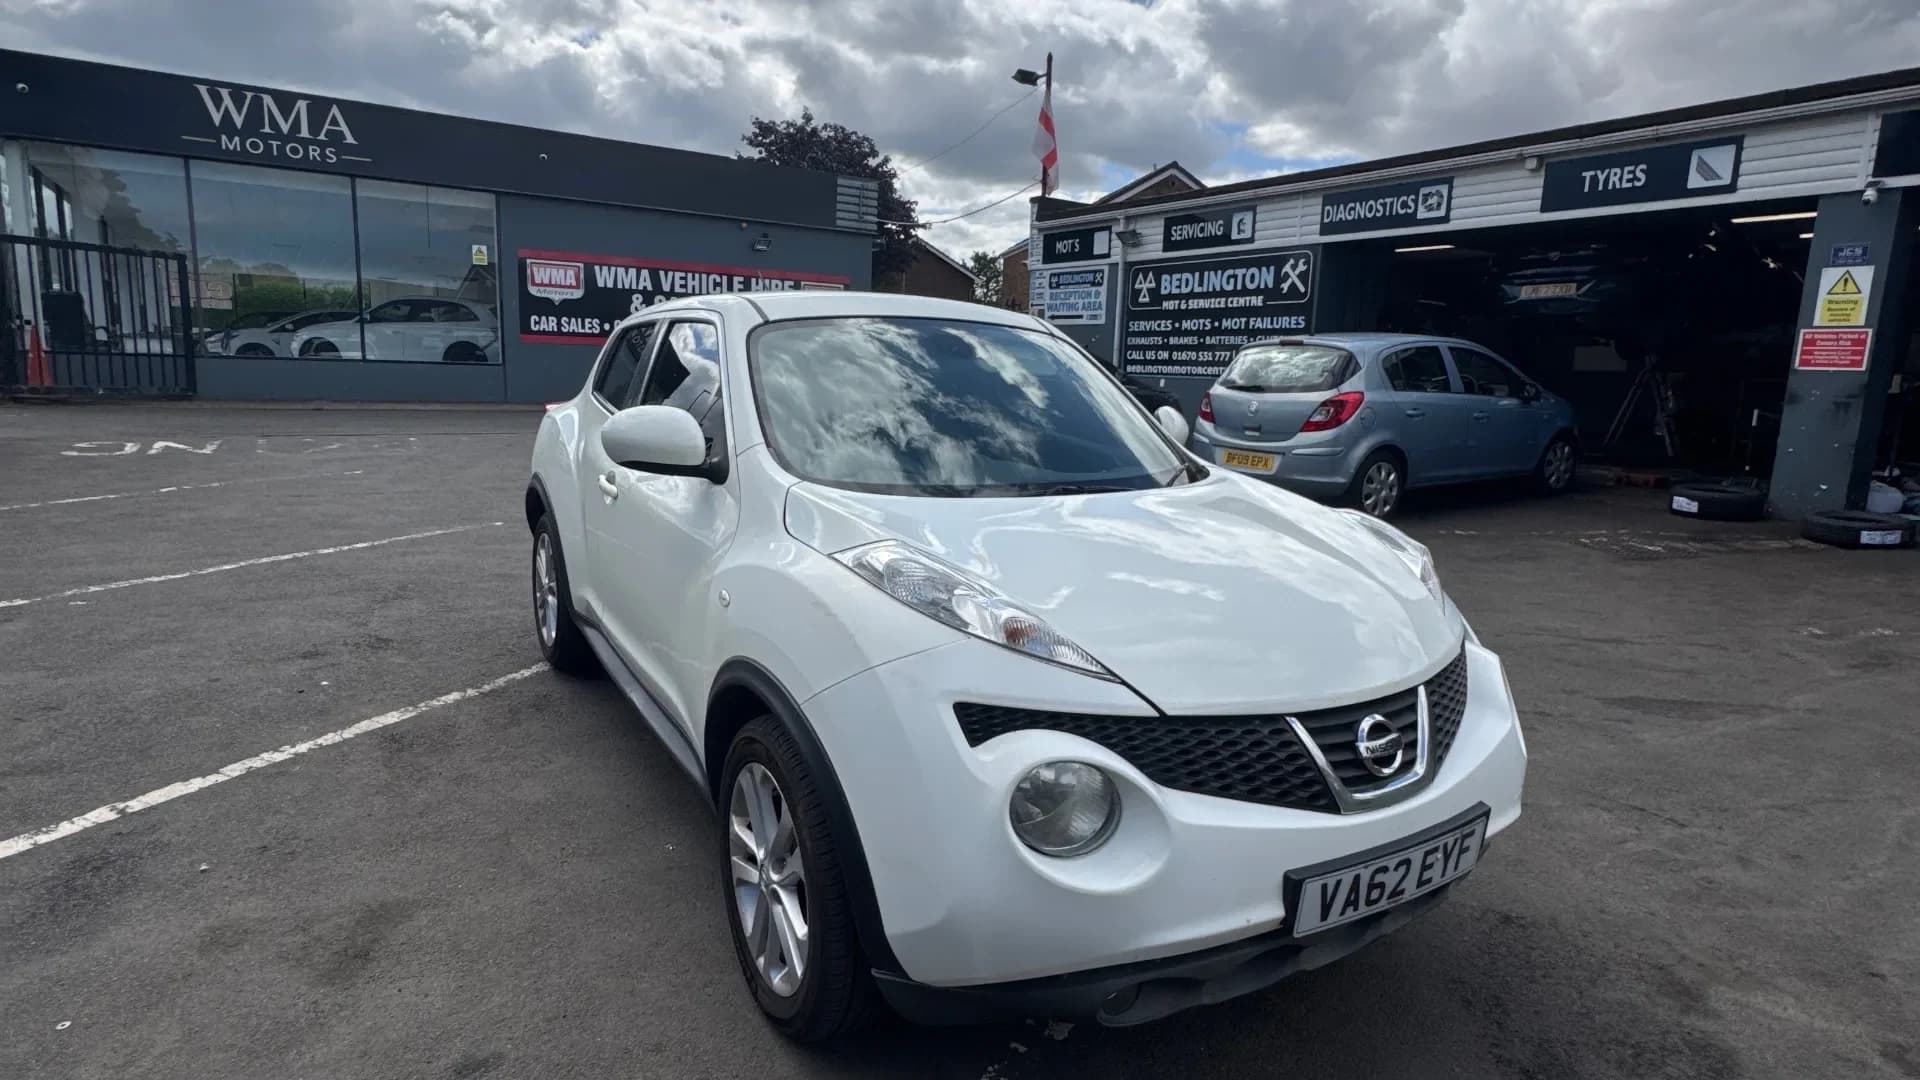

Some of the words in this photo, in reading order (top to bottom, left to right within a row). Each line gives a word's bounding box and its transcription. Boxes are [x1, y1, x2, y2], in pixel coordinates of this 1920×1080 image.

[193, 84, 359, 144] WMA
[220, 134, 338, 163] MOTORS
[1582, 164, 1647, 193] TYRES
[1323, 195, 1415, 223] DIAGNOSTICS
[1170, 220, 1224, 241] SERVICING
[533, 266, 577, 287] WMA
[594, 265, 653, 292] WMA
[659, 270, 746, 294] VEHICLE
[1160, 266, 1275, 295] BEDLINGTON
[630, 293, 648, 314] &
[1049, 290, 1091, 301] RECEPTION
[1162, 300, 1179, 311] MOT
[1180, 300, 1187, 310] &
[1188, 298, 1226, 310] SERVICE
[1227, 296, 1264, 308] CENTRE
[1046, 302, 1079, 313] WAITING
[1081, 301, 1103, 312] AREA
[530, 315, 558, 332] CAR
[560, 317, 601, 334] SALES
[1128, 320, 1172, 332] SERVICES
[1181, 319, 1211, 331] MOTS
[1221, 318, 1247, 330] MOT
[1249, 316, 1306, 329] FAILURES
[1127, 336, 1162, 345] EXHAUSTS
[1168, 336, 1198, 345] BRAKES
[1205, 336, 1248, 345] BATTERIES
[1127, 350, 1144, 360] CALL
[1145, 350, 1156, 360] US
[1157, 351, 1169, 360] ON
[1171, 351, 1196, 361] 01670
[1214, 351, 1230, 361] 777
[1320, 857, 1412, 922] VA62
[1416, 830, 1475, 890] EYF
